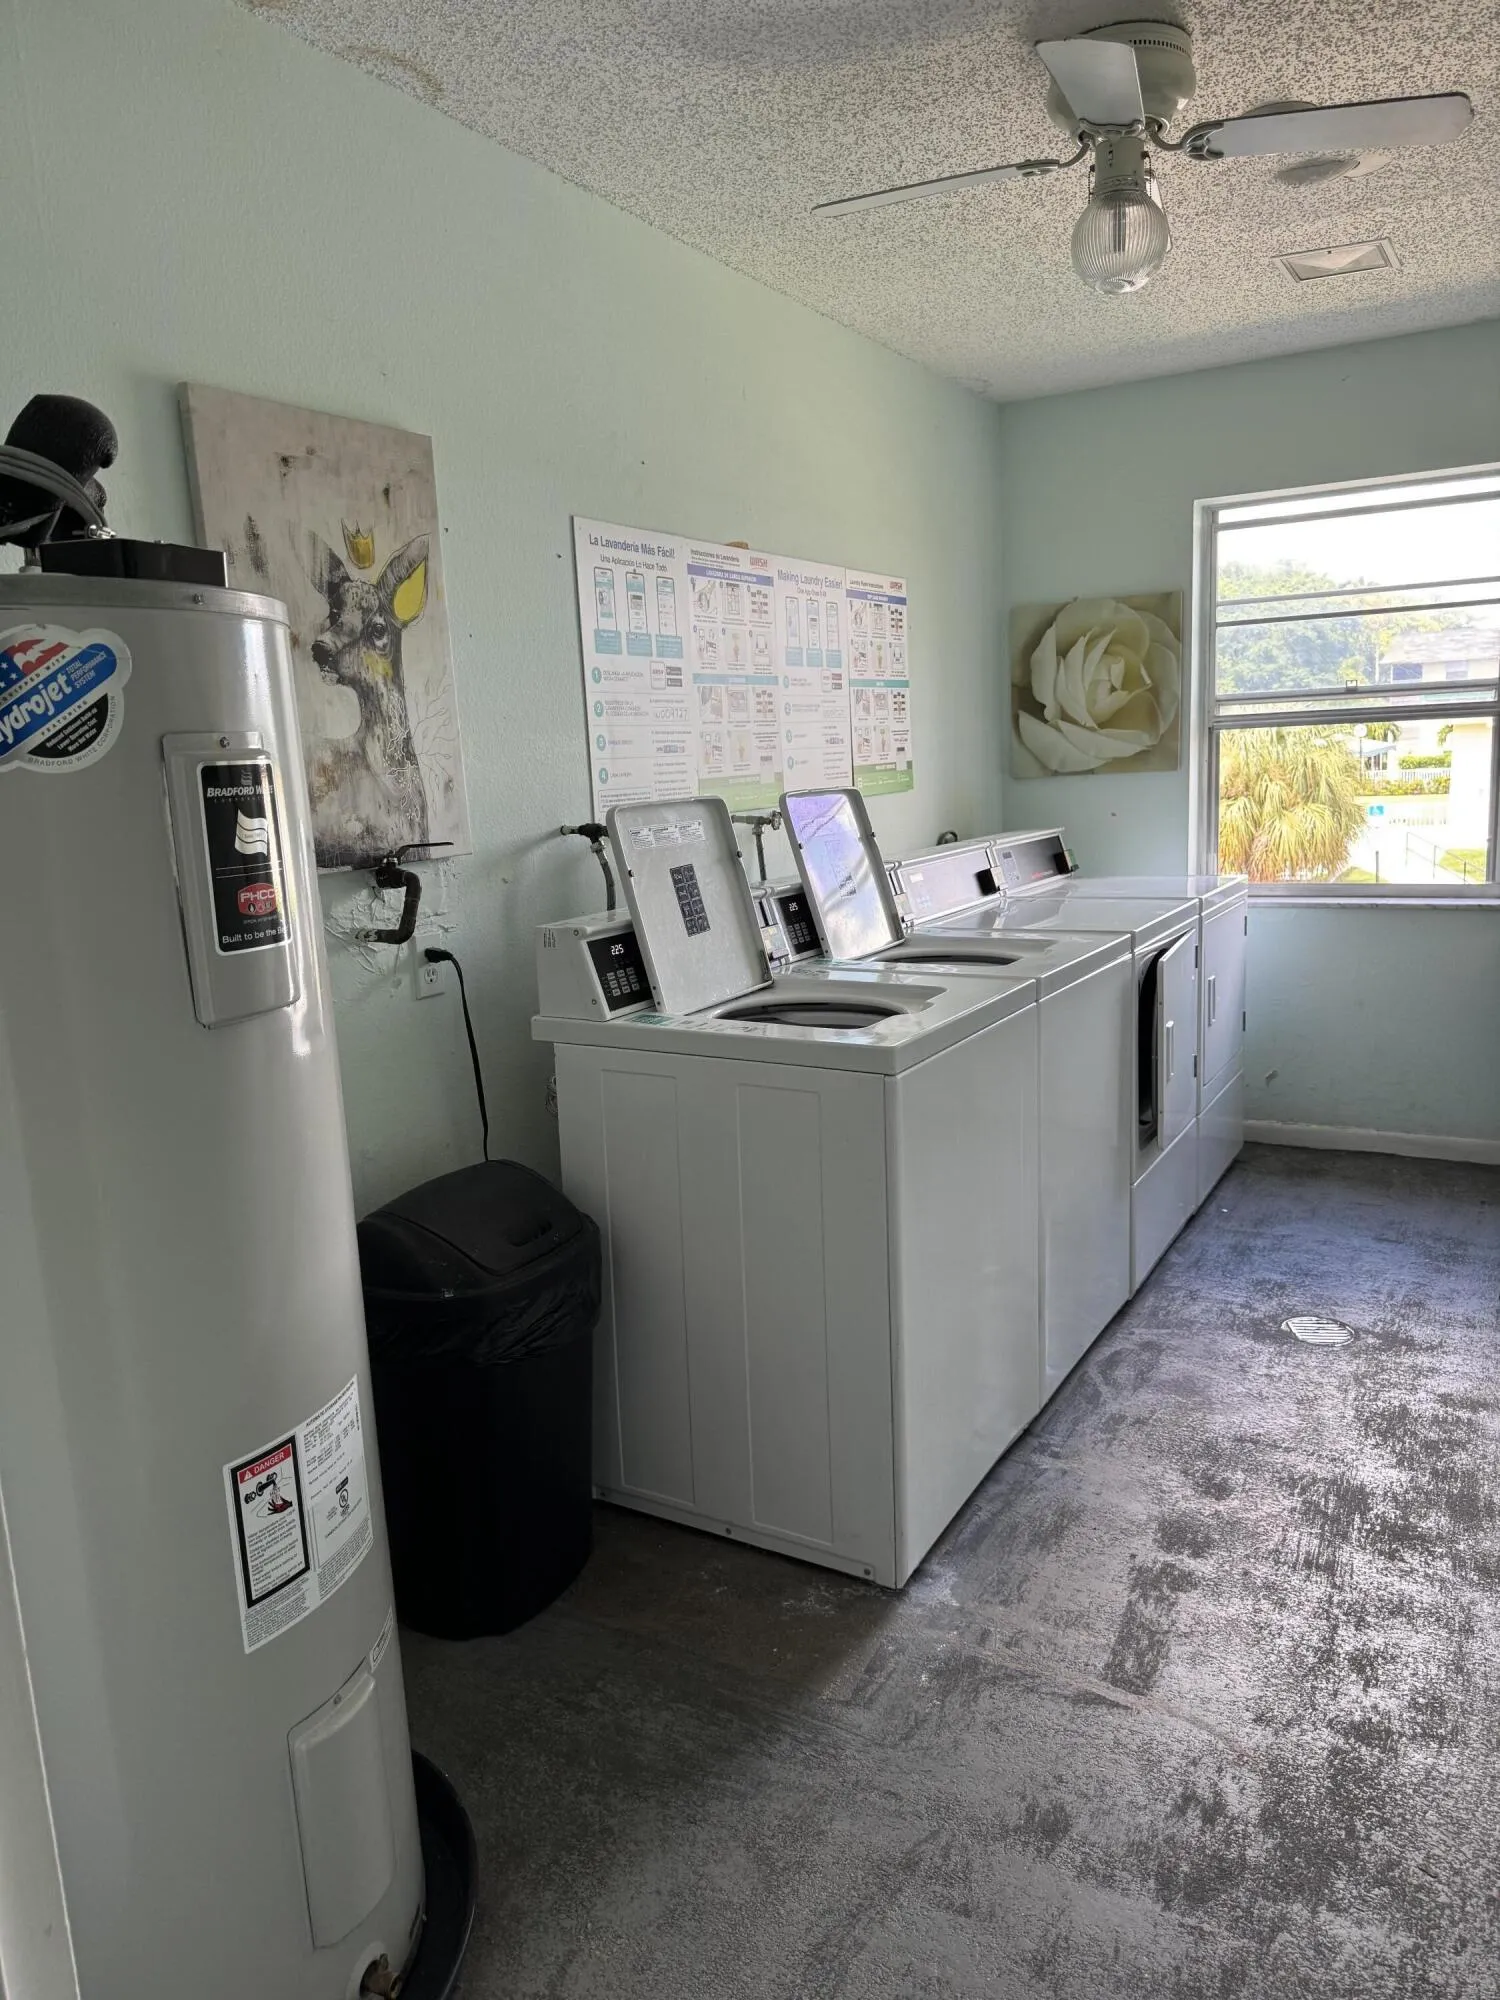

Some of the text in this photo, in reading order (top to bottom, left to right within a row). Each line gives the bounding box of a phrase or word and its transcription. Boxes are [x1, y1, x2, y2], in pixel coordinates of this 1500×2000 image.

[588, 533, 599, 546] La
[640, 543, 656, 556] Más
[600, 554, 611, 564] Una
[643, 561, 655, 570] Hace
[749, 555, 768, 568] WASH
[777, 569, 800, 586] Making
[800, 574, 824, 589] Laundry
[74, 669, 96, 689] SYSTEM
[0, 672, 72, 745] ydrojet
[27, 694, 117, 767] BRADFORD WHITE CORPORATION
[206, 786, 255, 799] BRADFORD
[222, 933, 243, 944] Built
[243, 933, 254, 941] to
[254, 930, 265, 939] be
[265, 928, 277, 937] the
[253, 1451, 285, 1474] DANGER
